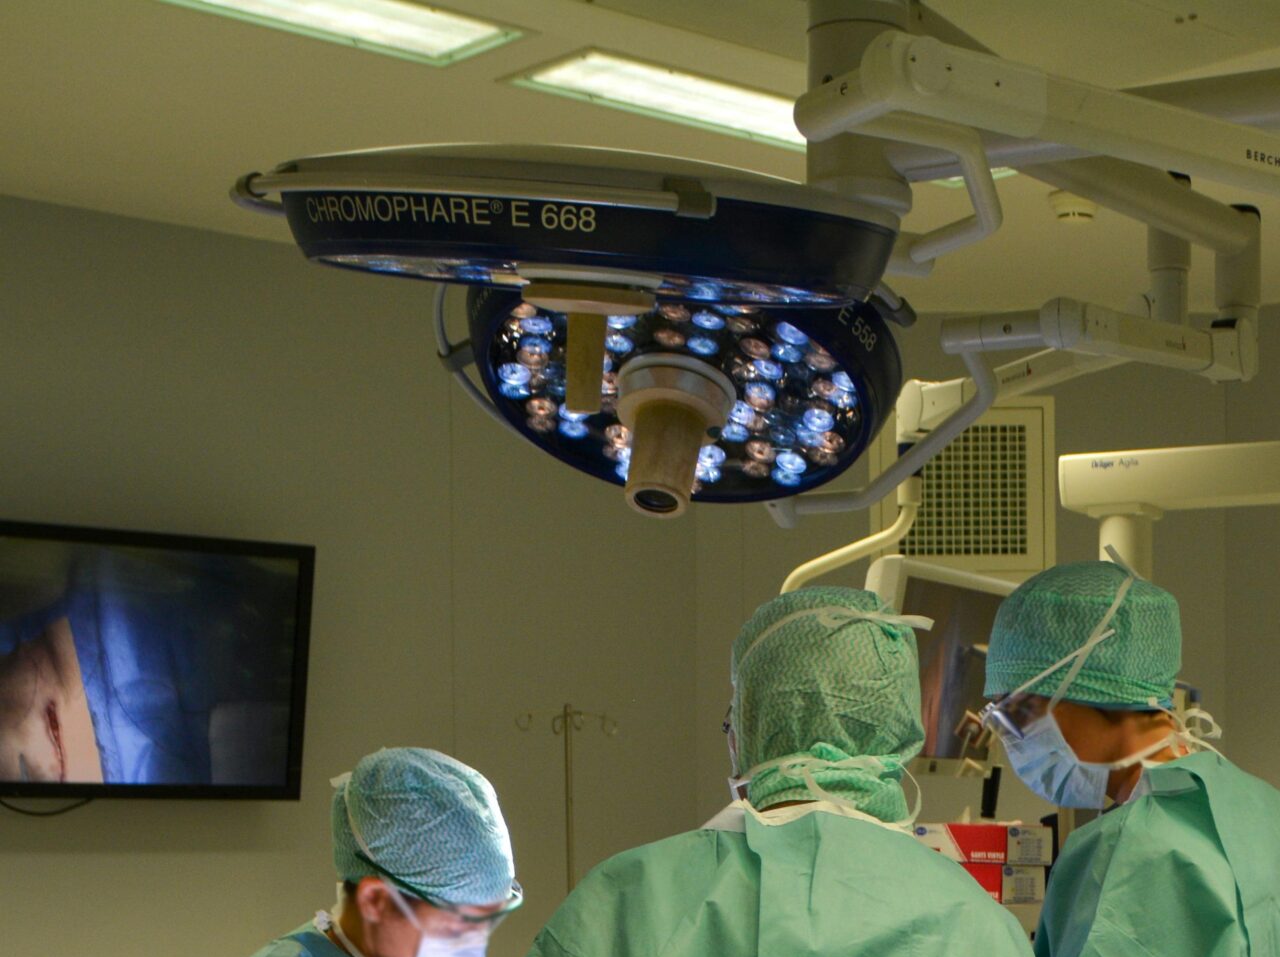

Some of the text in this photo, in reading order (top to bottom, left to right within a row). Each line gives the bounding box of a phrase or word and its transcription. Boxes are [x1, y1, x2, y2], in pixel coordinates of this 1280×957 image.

[511, 201, 530, 228] E
[541, 204, 596, 232] 668
[838, 305, 877, 352] E 558
